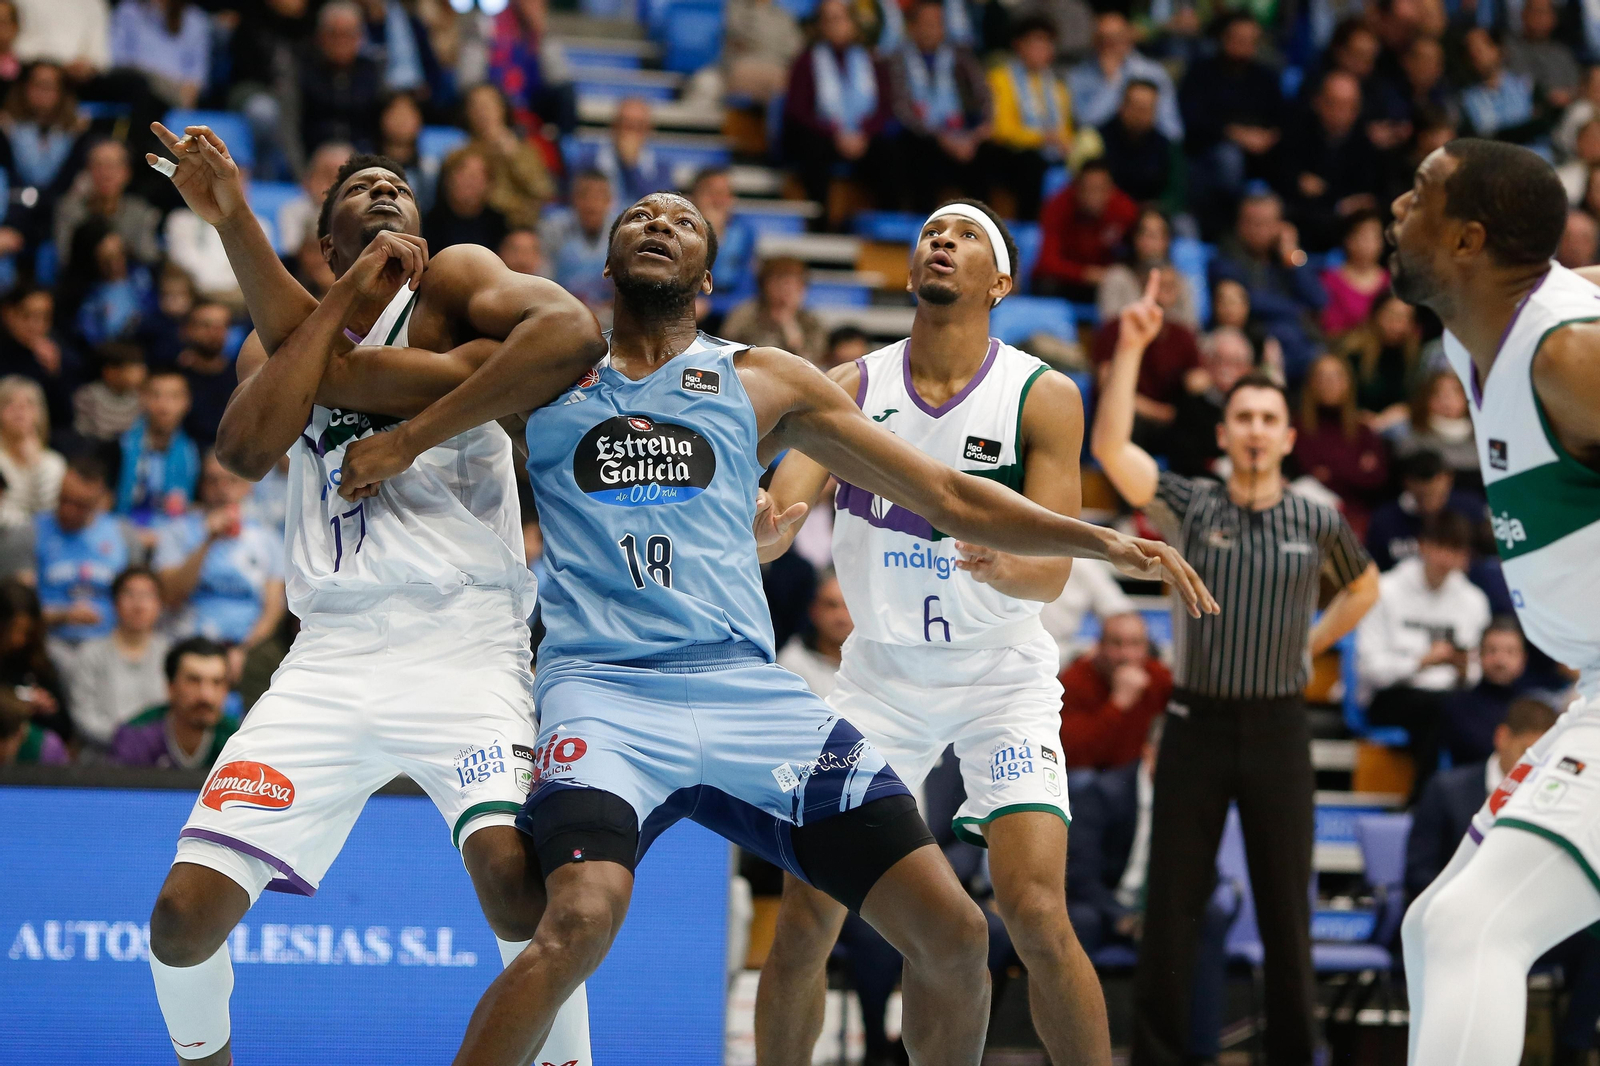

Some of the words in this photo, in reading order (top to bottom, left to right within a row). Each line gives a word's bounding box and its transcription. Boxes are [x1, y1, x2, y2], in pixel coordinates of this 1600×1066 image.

[685, 374, 701, 383] liga
[685, 381, 718, 392] endesa
[596, 433, 694, 461] Estrella
[967, 443, 983, 453] liga
[966, 451, 998, 462] endesa
[600, 456, 691, 484] Galicia
[630, 481, 661, 503] 0,0
[330, 502, 366, 573] 17
[618, 533, 673, 590] 18
[514, 750, 533, 759] acb
[541, 764, 573, 781] ALICIA
[800, 767, 819, 779] DE
[228, 922, 393, 965] LESIAS
